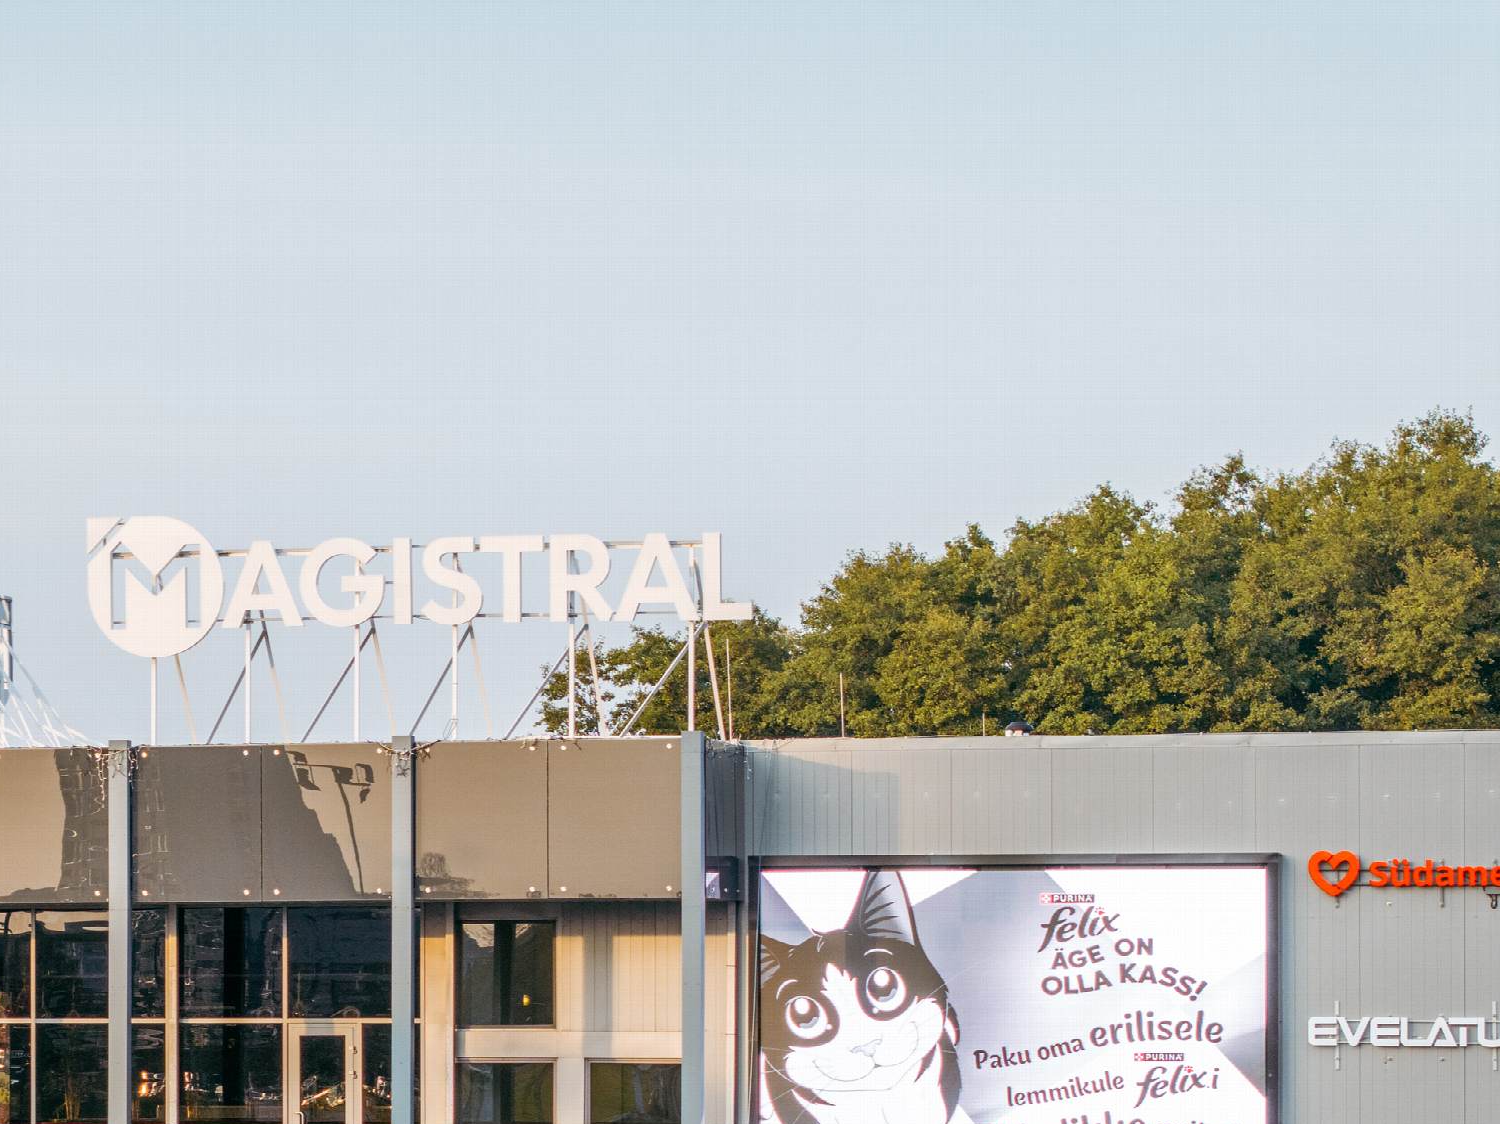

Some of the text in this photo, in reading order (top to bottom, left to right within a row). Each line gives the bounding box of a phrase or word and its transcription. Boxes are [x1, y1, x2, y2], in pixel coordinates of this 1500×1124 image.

[87, 516, 752, 657] MAGISTRAL
[1038, 905, 1120, 953] felix
[1051, 938, 1153, 970] ÄGE ON
[1041, 963, 1208, 1001] OLLA KASS!
[973, 1010, 1224, 1069] Paku oma erilisele
[1007, 1071, 1125, 1107] lemmikule
